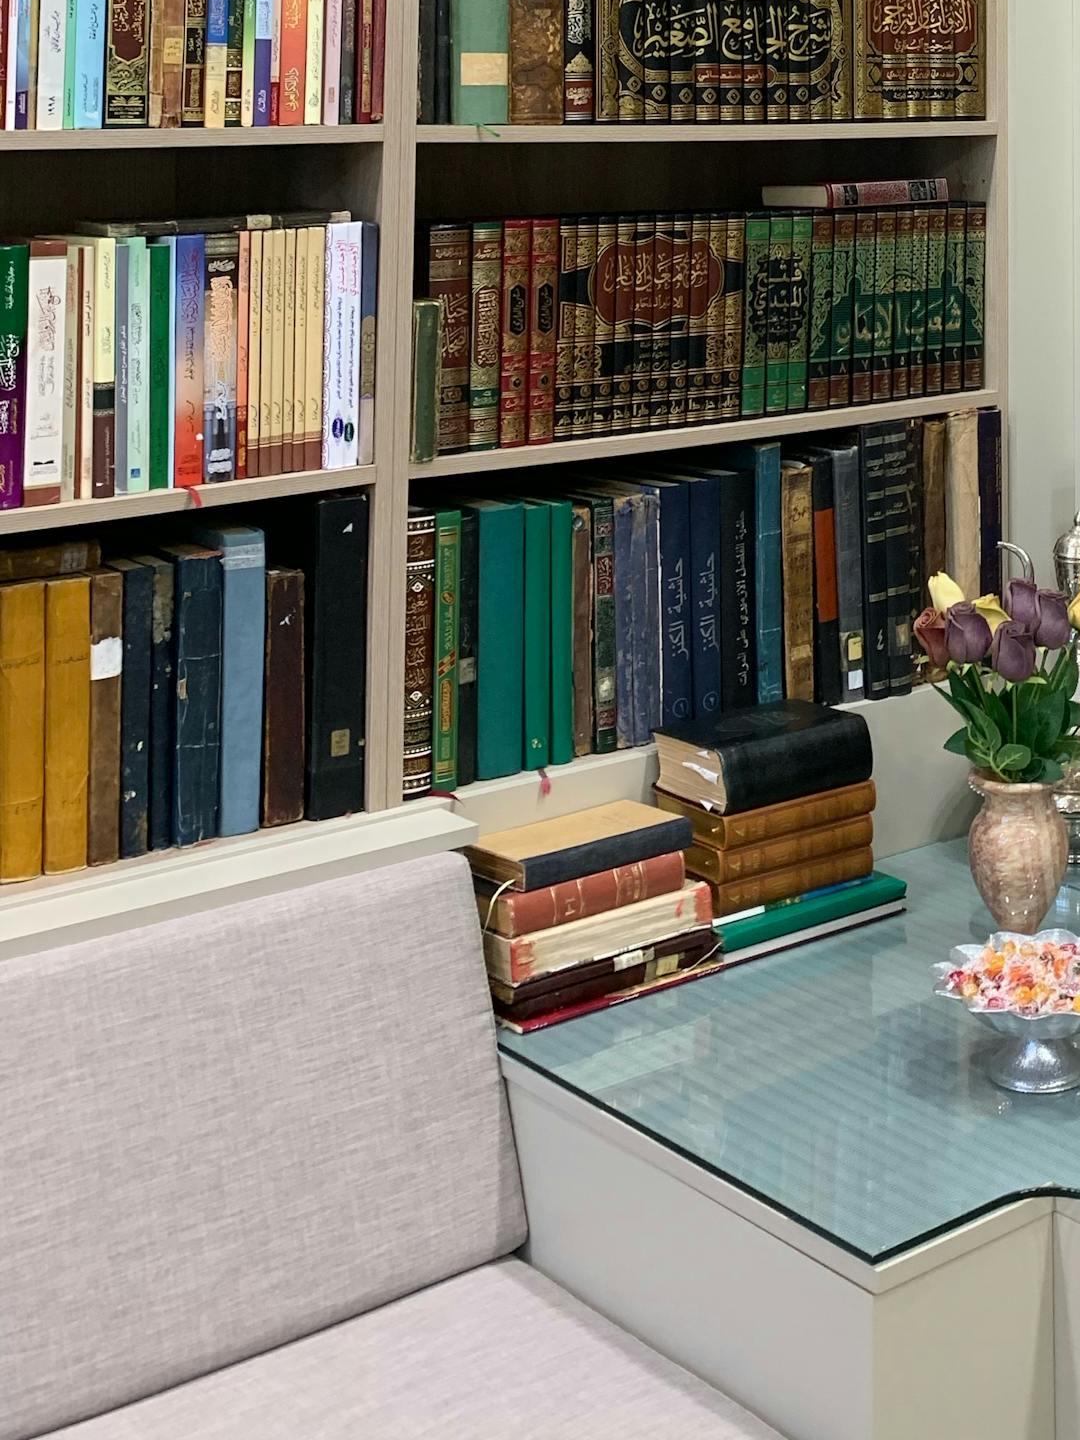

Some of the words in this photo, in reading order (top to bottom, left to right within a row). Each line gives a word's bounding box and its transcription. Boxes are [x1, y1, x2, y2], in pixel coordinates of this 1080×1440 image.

[633, 1, 719, 58] الصغير
[721, 2, 784, 62] الجامع
[787, 5, 833, 62] شرح
[756, 259, 803, 289] فتح
[835, 300, 894, 355] الإيمان
[909, 295, 961, 344] شعب
[668, 558, 687, 615] حاشية
[699, 553, 717, 609] حاشية
[669, 620, 690, 658] الكنز
[700, 613, 719, 652] الكنز
